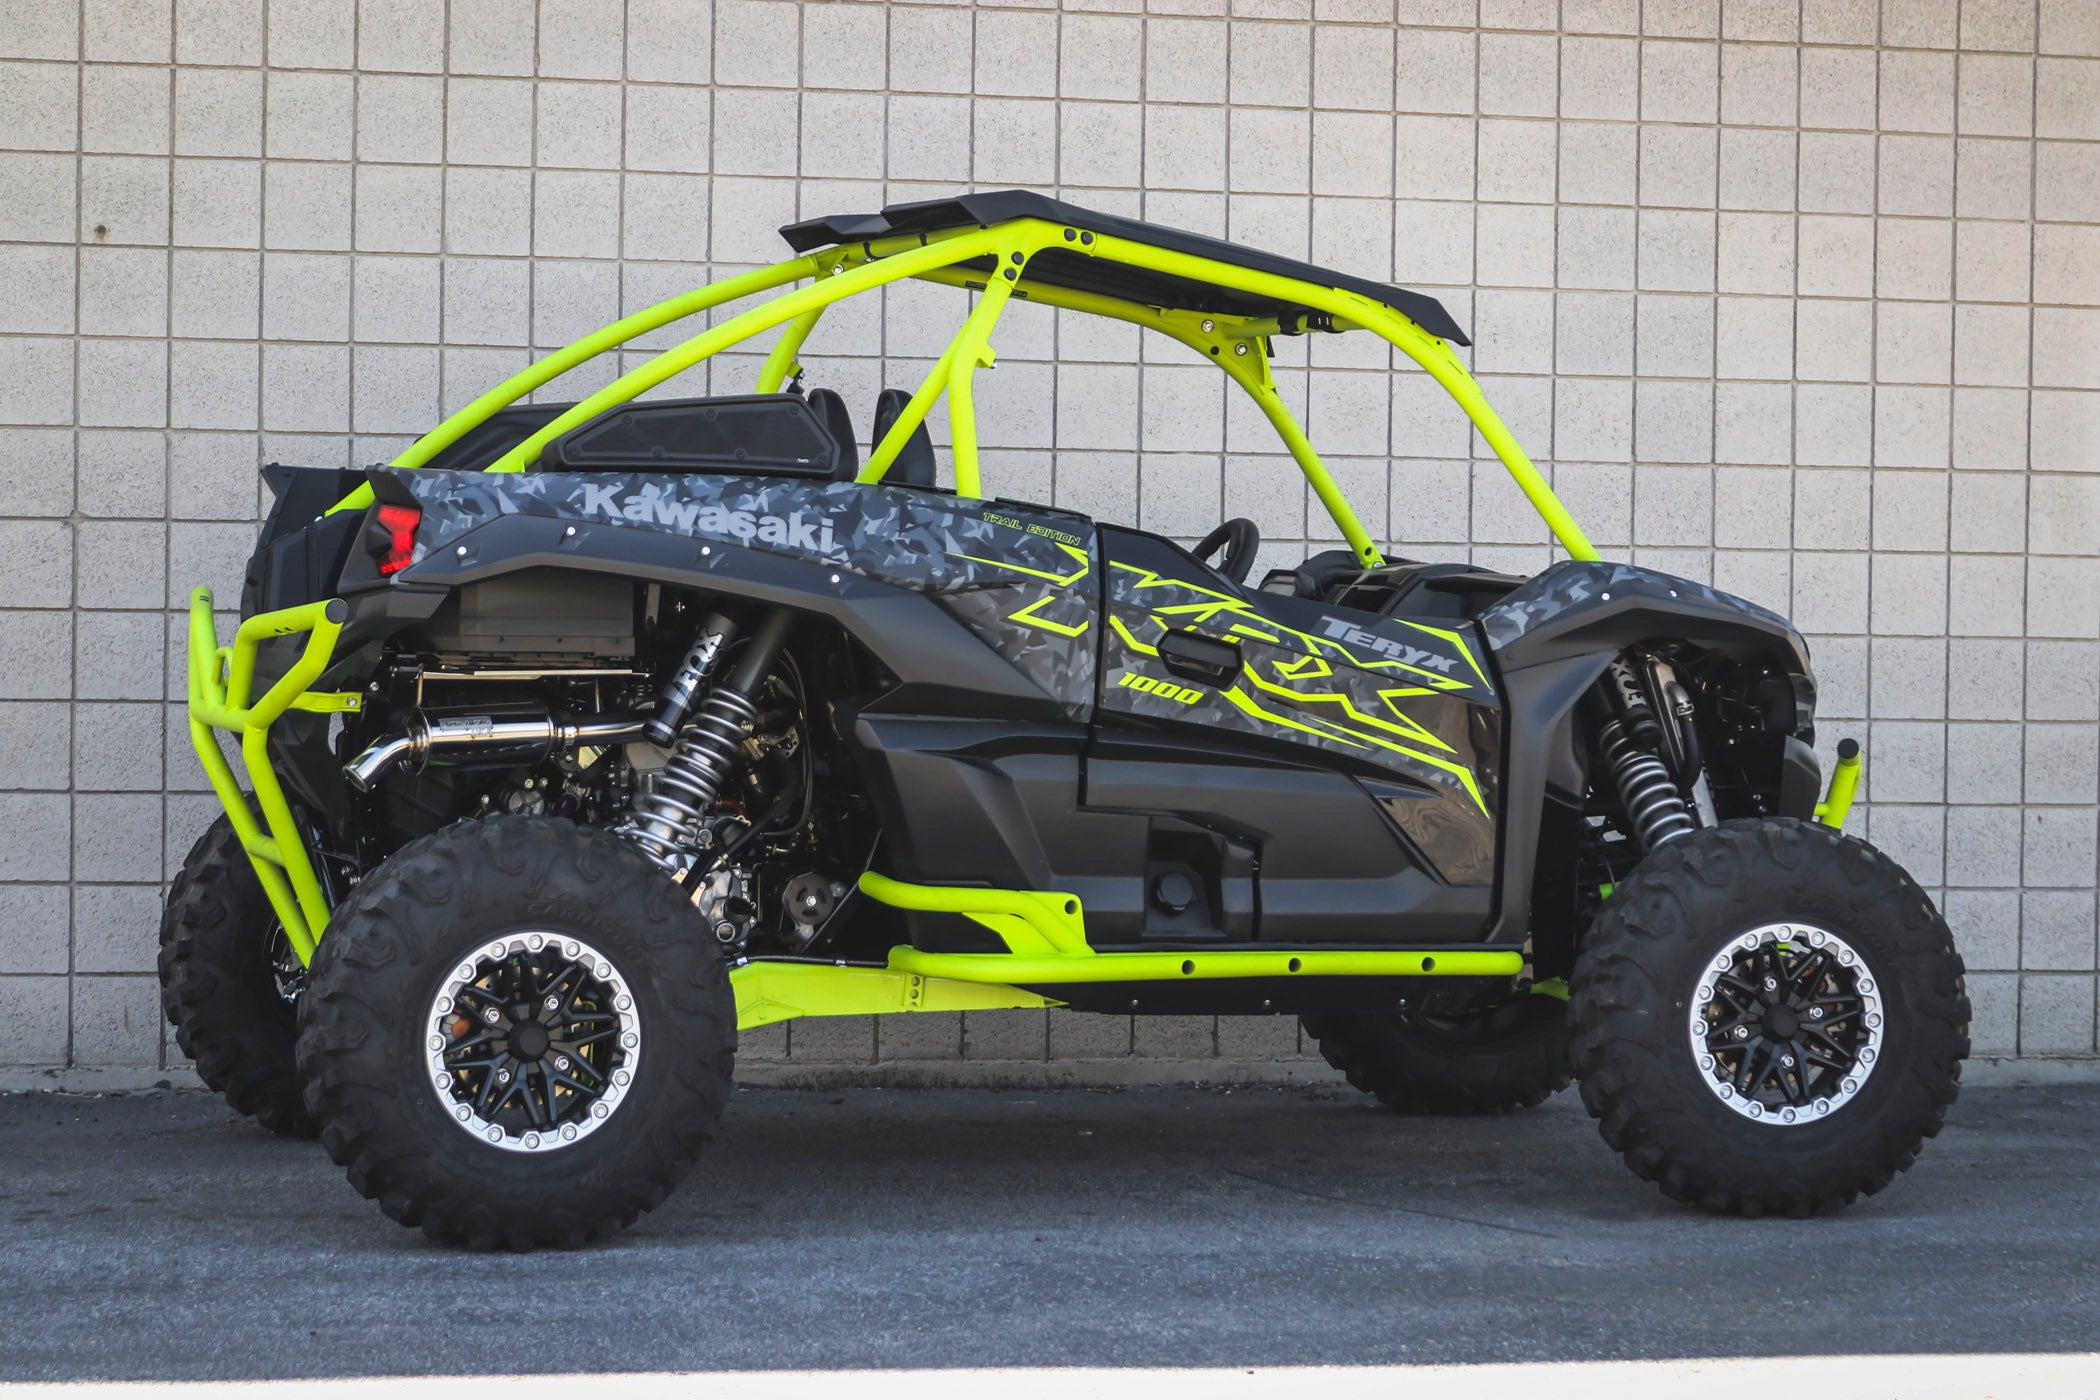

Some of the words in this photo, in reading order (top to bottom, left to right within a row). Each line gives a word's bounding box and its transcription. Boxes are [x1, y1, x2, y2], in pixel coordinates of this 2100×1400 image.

[582, 482, 834, 553] Kawasaki
[983, 511, 1023, 531] TRAIL
[1026, 523, 1081, 546] EDITION
[672, 627, 725, 693] FOX
[1321, 615, 1459, 673] TERYX
[1118, 671, 1204, 705] 1000
[1610, 657, 1647, 710] FOX
